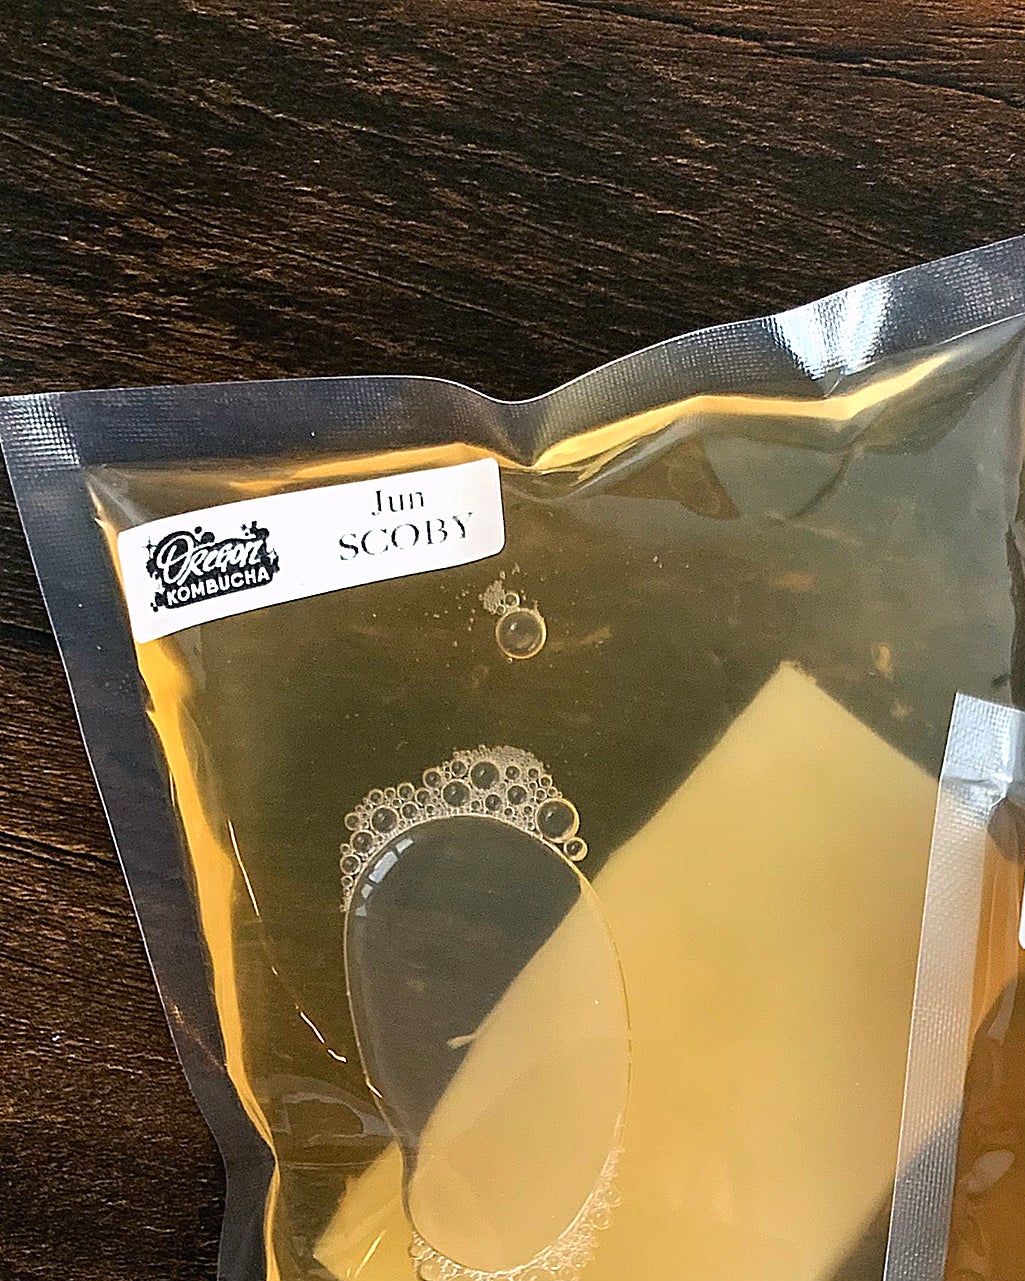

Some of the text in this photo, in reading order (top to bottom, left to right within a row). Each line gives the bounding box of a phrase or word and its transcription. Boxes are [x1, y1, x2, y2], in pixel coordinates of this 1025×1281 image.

[371, 489, 425, 516] Jun
[338, 511, 474, 561] SCOBY
[166, 566, 271, 606] KOMBUCHA
